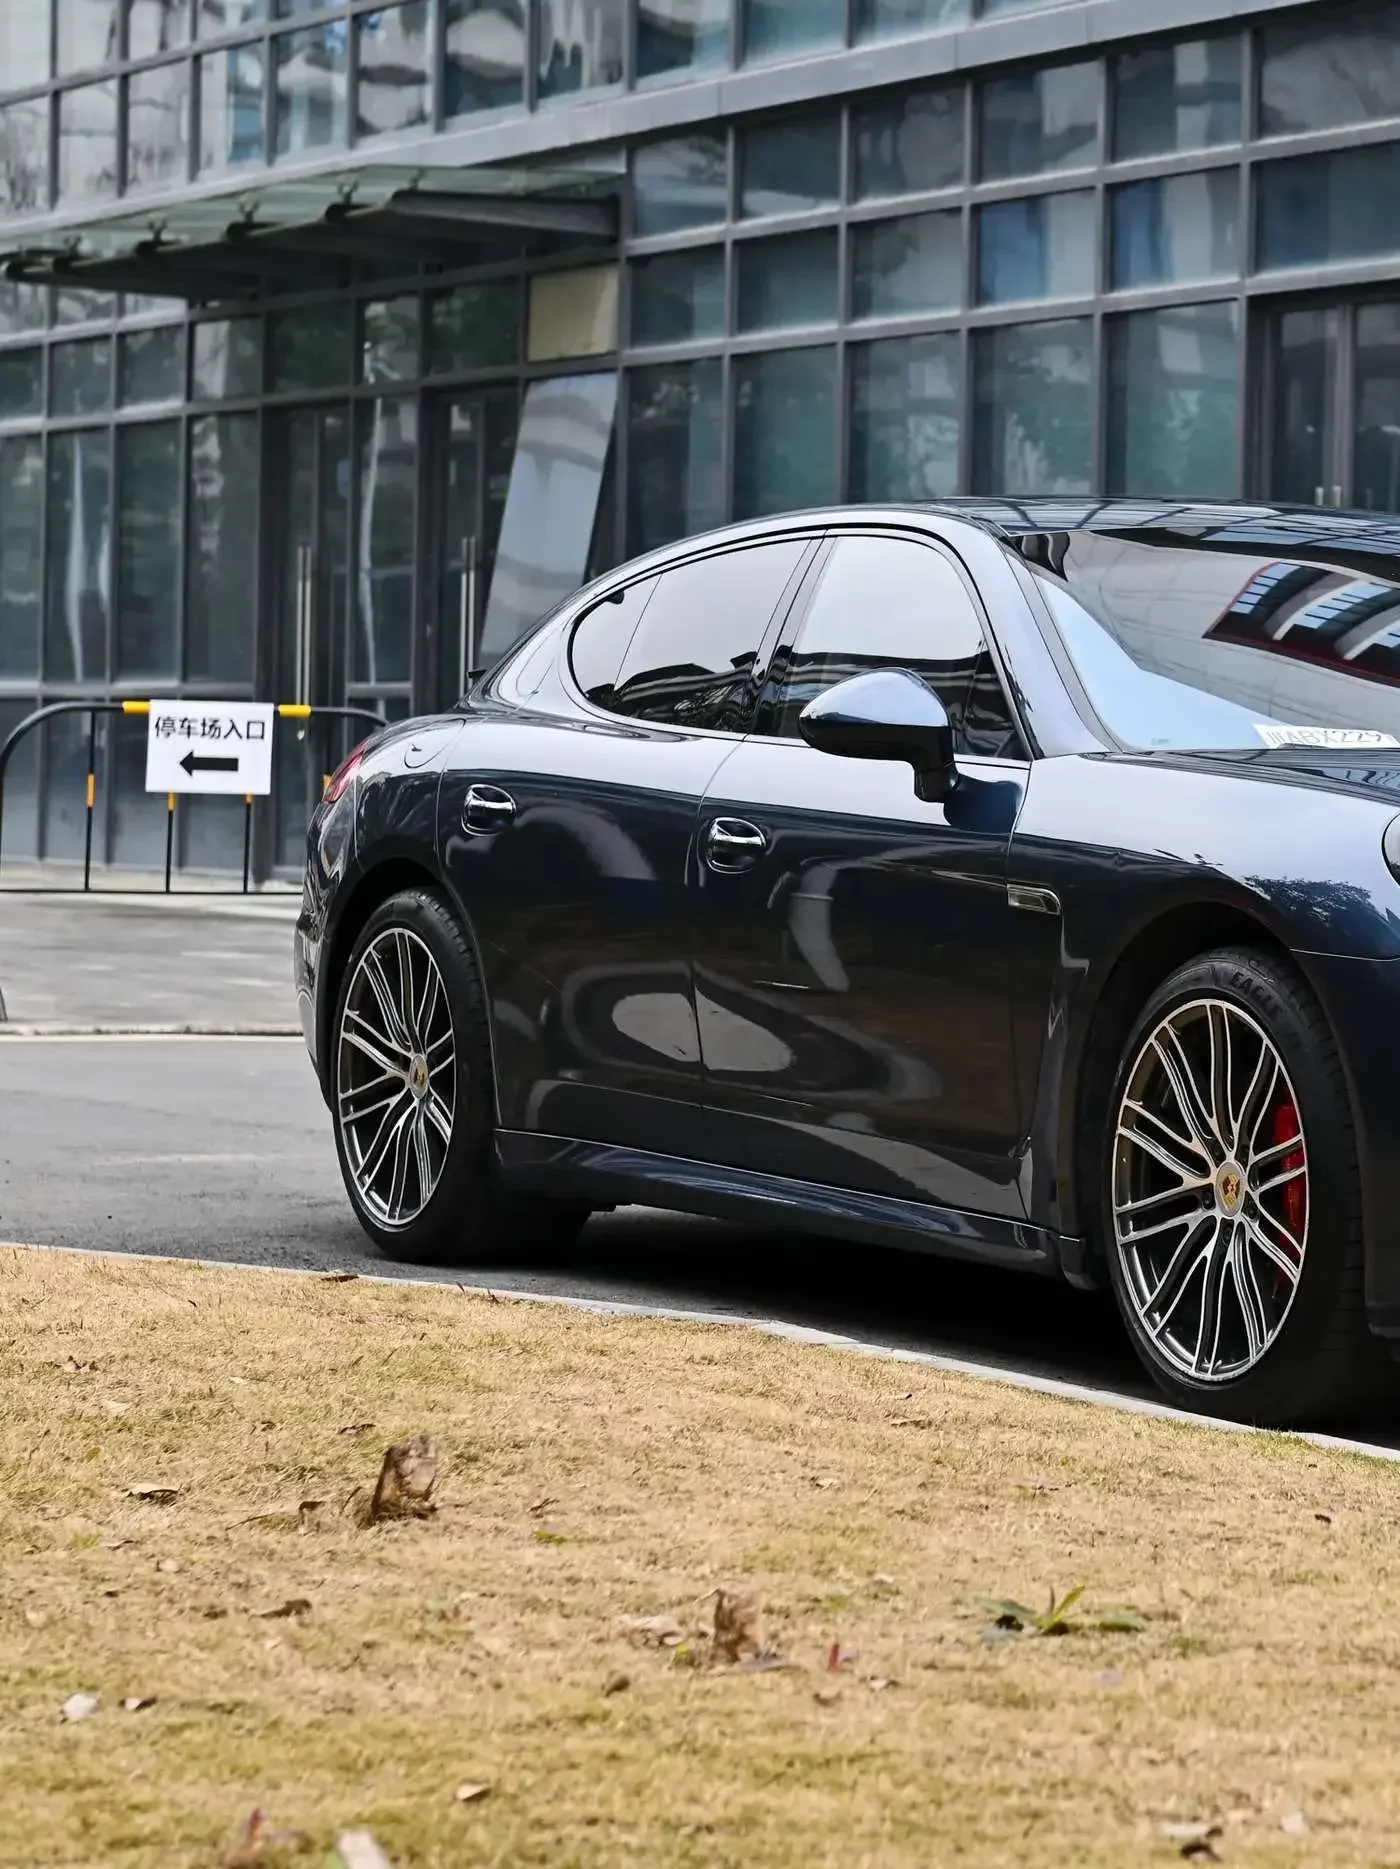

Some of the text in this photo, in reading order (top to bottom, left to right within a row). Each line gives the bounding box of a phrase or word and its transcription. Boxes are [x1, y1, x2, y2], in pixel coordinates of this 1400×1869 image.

[154, 716, 266, 740] 停车场入口
